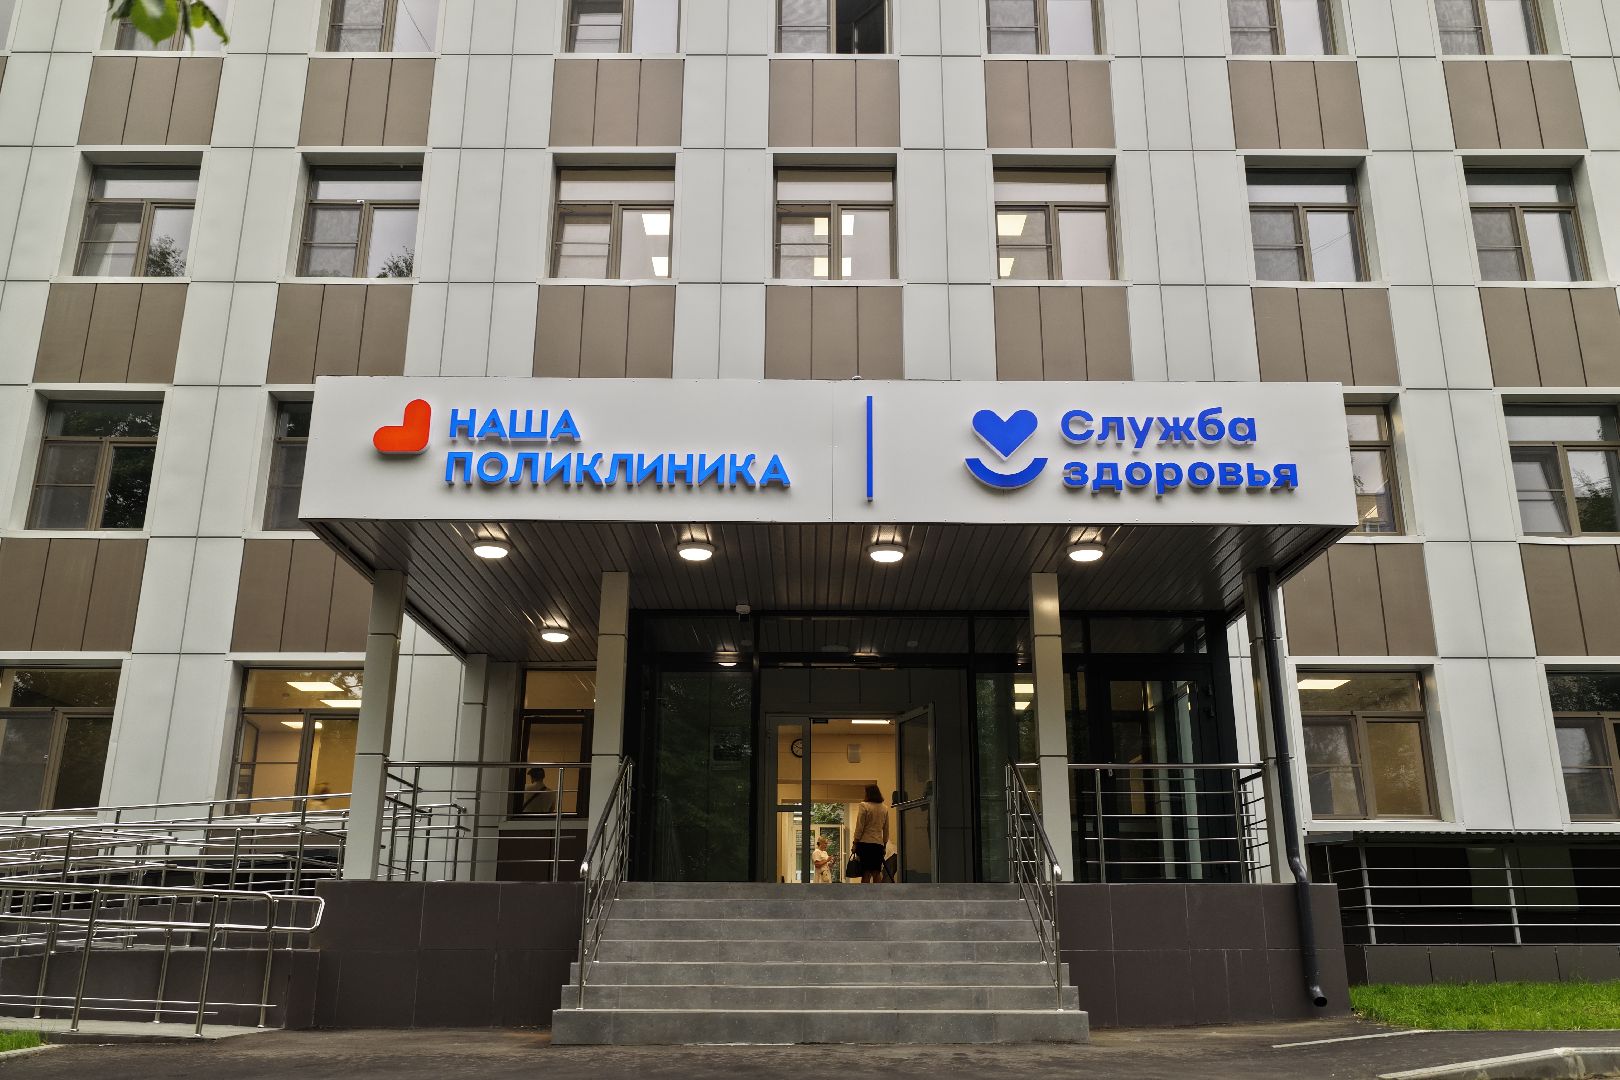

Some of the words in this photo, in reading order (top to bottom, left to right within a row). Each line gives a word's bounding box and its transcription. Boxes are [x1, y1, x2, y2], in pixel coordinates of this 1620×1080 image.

[449, 408, 581, 439] НАША
[1060, 406, 1257, 449] Служба
[444, 451, 791, 486] ПОЛИКЛИНИКА
[1063, 461, 1299, 495] здоровья
